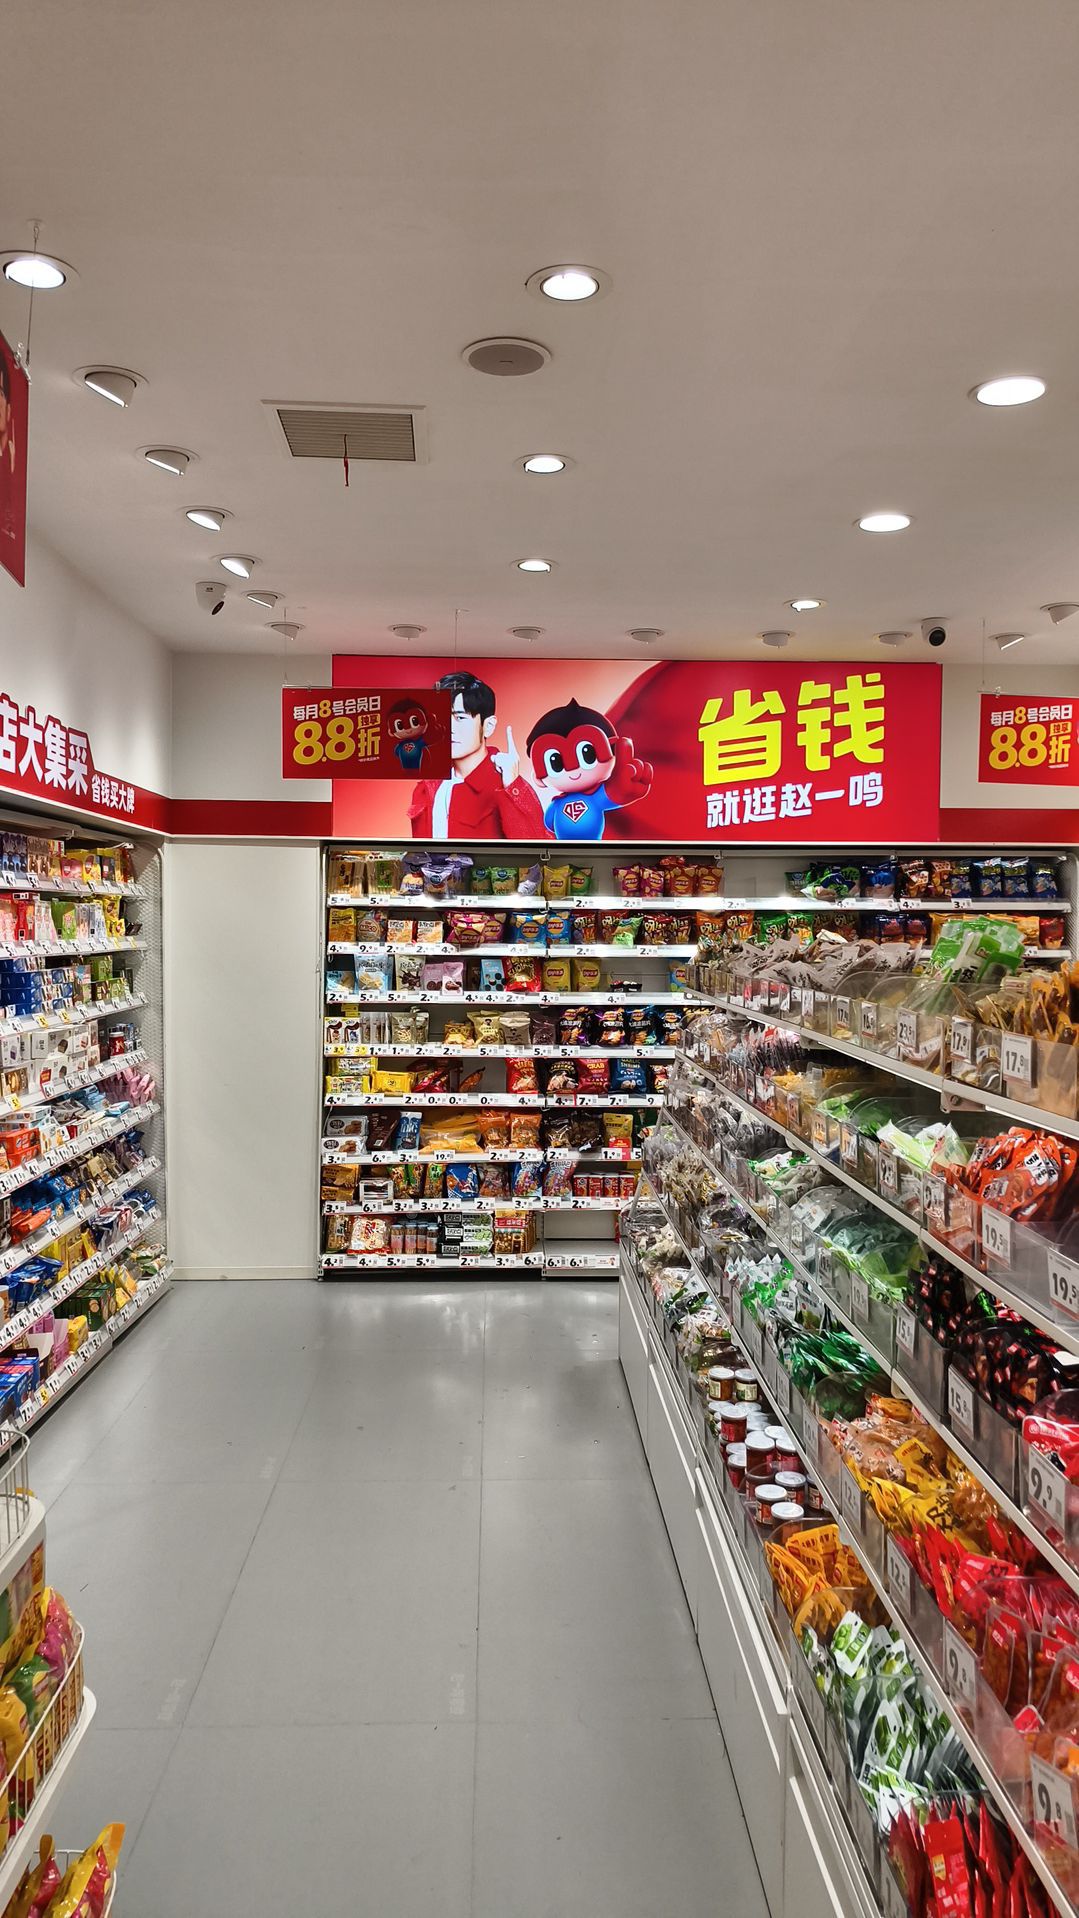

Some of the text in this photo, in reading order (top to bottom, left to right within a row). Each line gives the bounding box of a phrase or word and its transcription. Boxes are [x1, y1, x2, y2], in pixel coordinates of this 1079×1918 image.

[293, 695, 381, 721] 每月8号会员日
[991, 704, 1072, 726] 每月8号会员日
[698, 672, 885, 786] 省钱
[92, 774, 135, 814] 省钱买大牌
[706, 772, 884, 828] 就逛赵一鸣
[985, 1224, 1004, 1251] 19.5
[1052, 1272, 1077, 1305] 19.5
[1031, 1466, 1053, 1509] 9.9
[1037, 1782, 1062, 1834] 9.8
